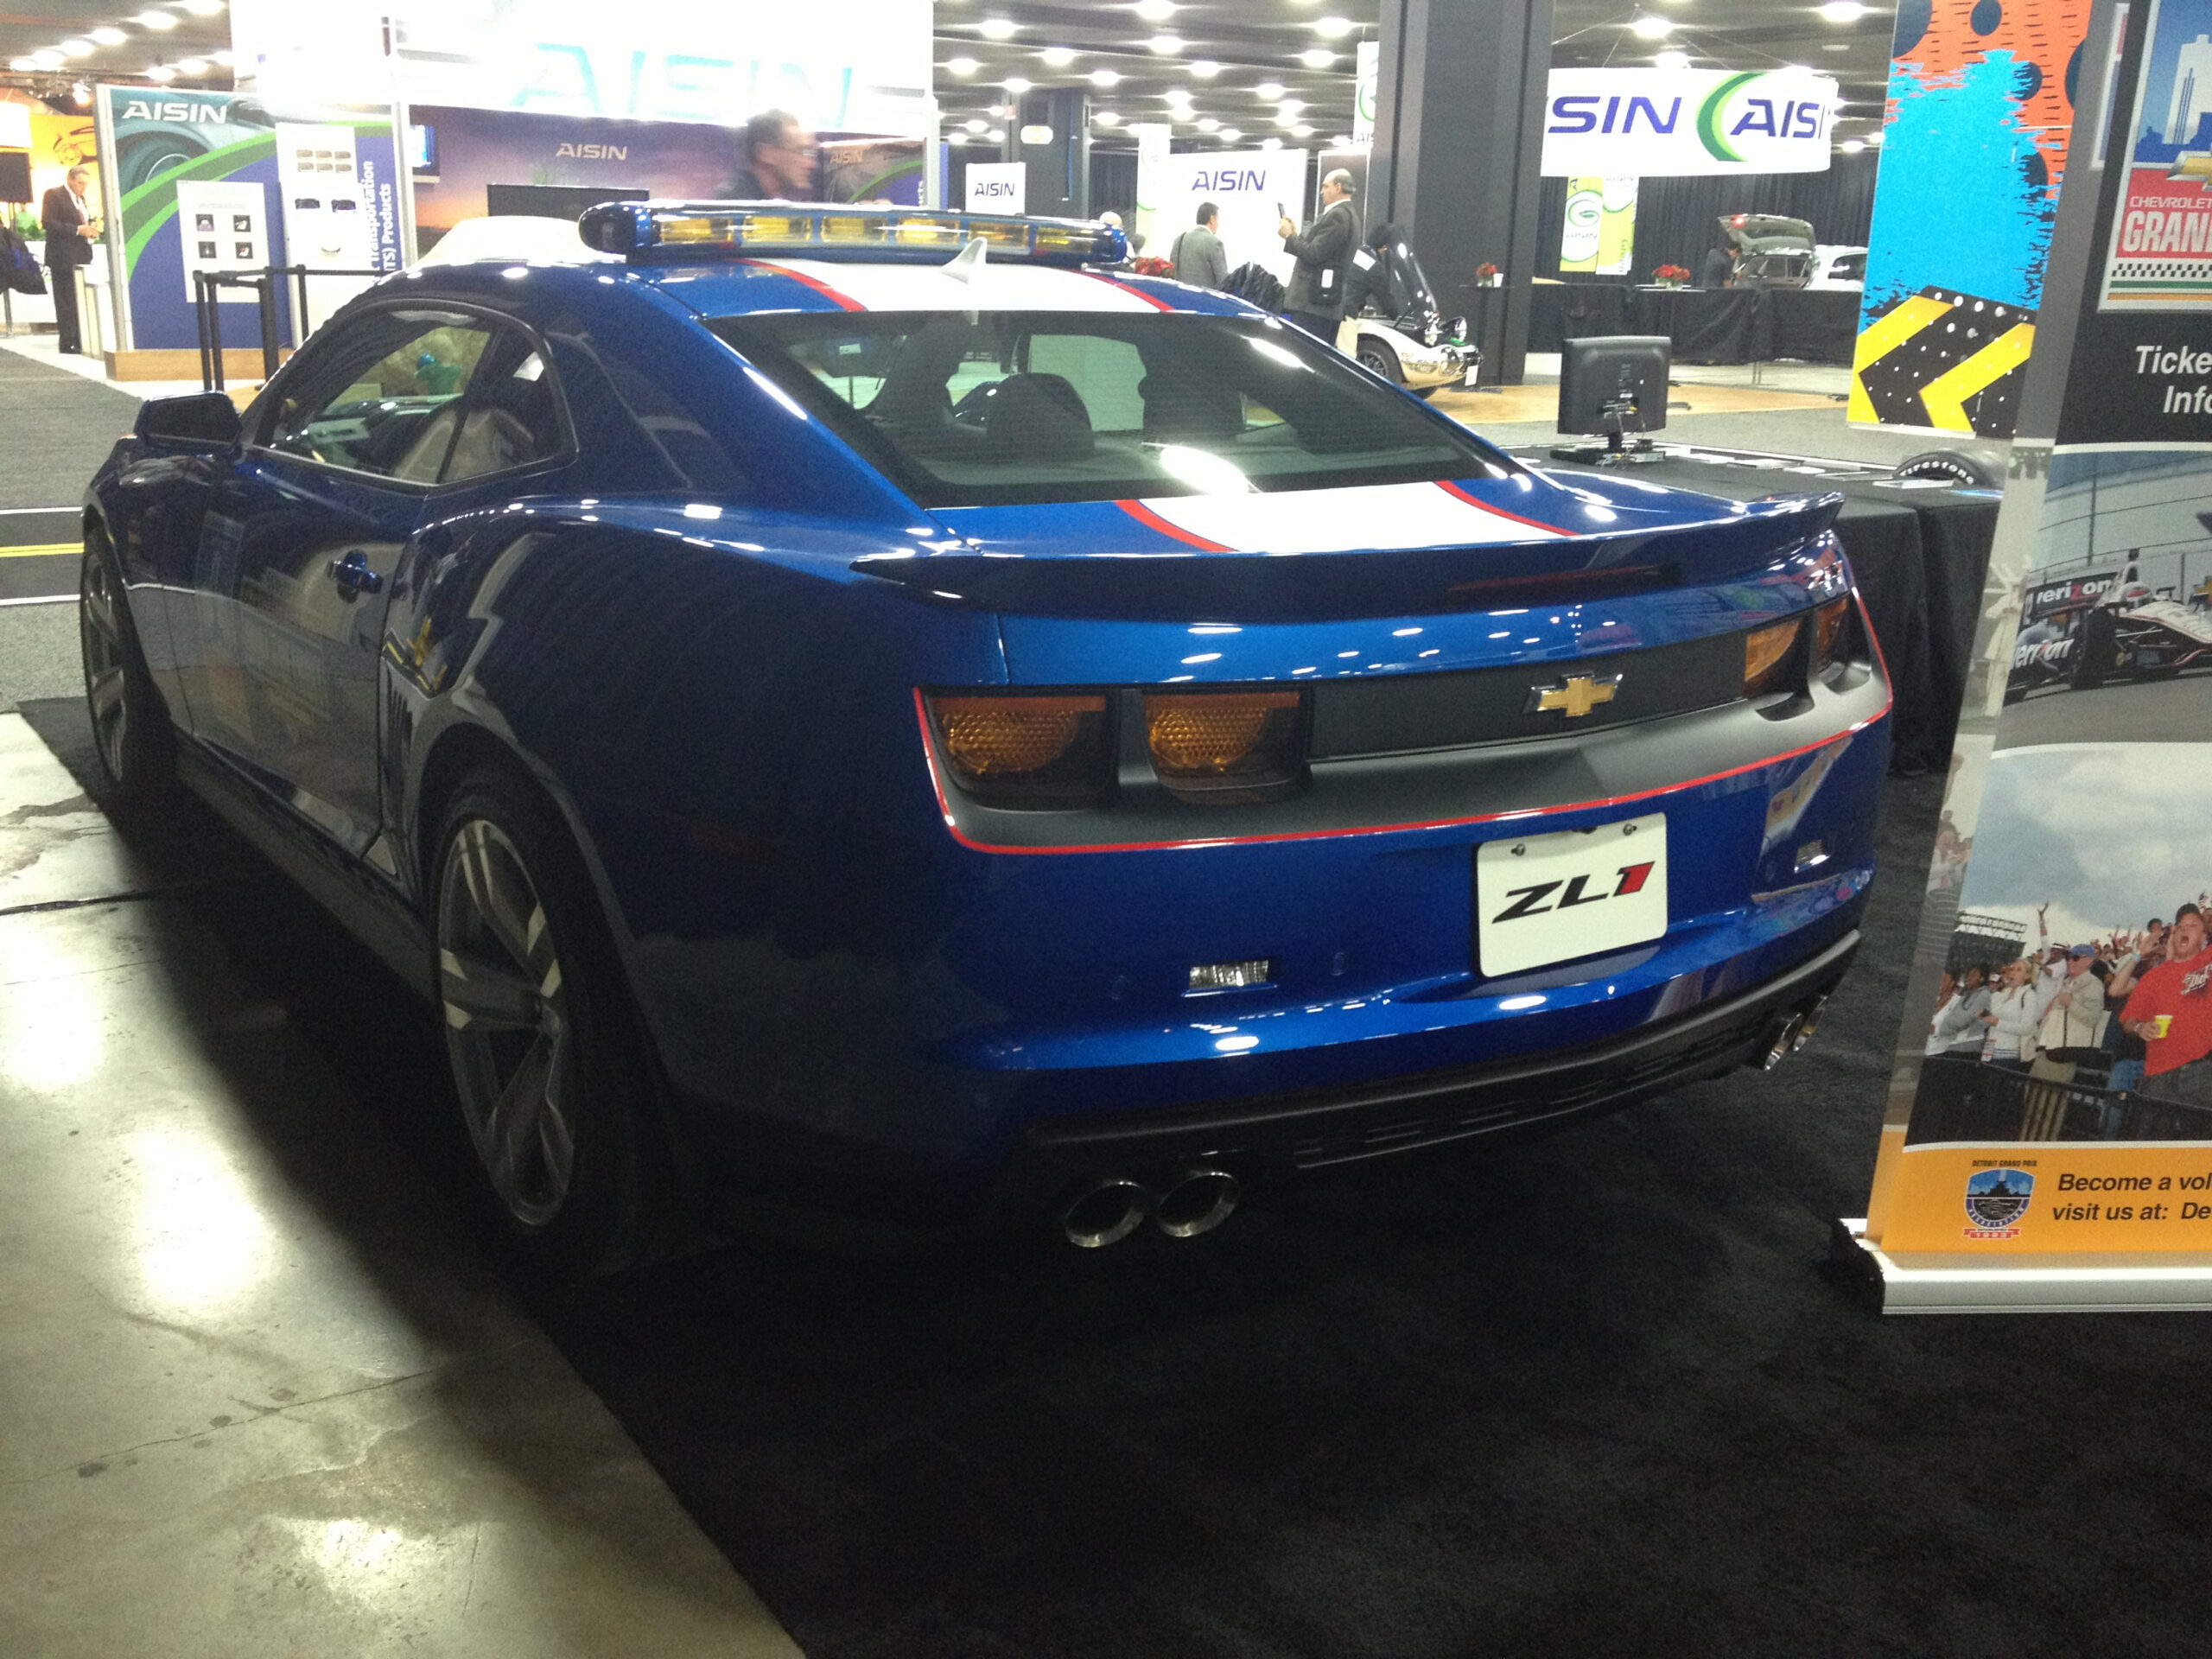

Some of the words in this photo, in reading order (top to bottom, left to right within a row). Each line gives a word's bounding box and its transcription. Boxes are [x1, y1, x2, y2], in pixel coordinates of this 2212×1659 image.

[122, 100, 227, 124] AISIN
[1548, 96, 1682, 134] SIN
[556, 143, 627, 161] AISIN
[830, 150, 864, 164] AISIN
[975, 182, 1015, 196] AISIN
[1192, 170, 1266, 191] AISIN
[2130, 196, 2212, 208] CHEVROLET
[379, 183, 394, 244] Products
[2136, 345, 2212, 374] Ticke
[1491, 861, 1656, 924] ZL1
[2058, 1173, 2152, 1191] Become
[2158, 1177, 2171, 1191] a
[2052, 1203, 2101, 1220] visit
[2106, 1206, 2133, 1220] us
[2139, 1204, 2169, 1220] at:
[2181, 1202, 2212, 1219] De
